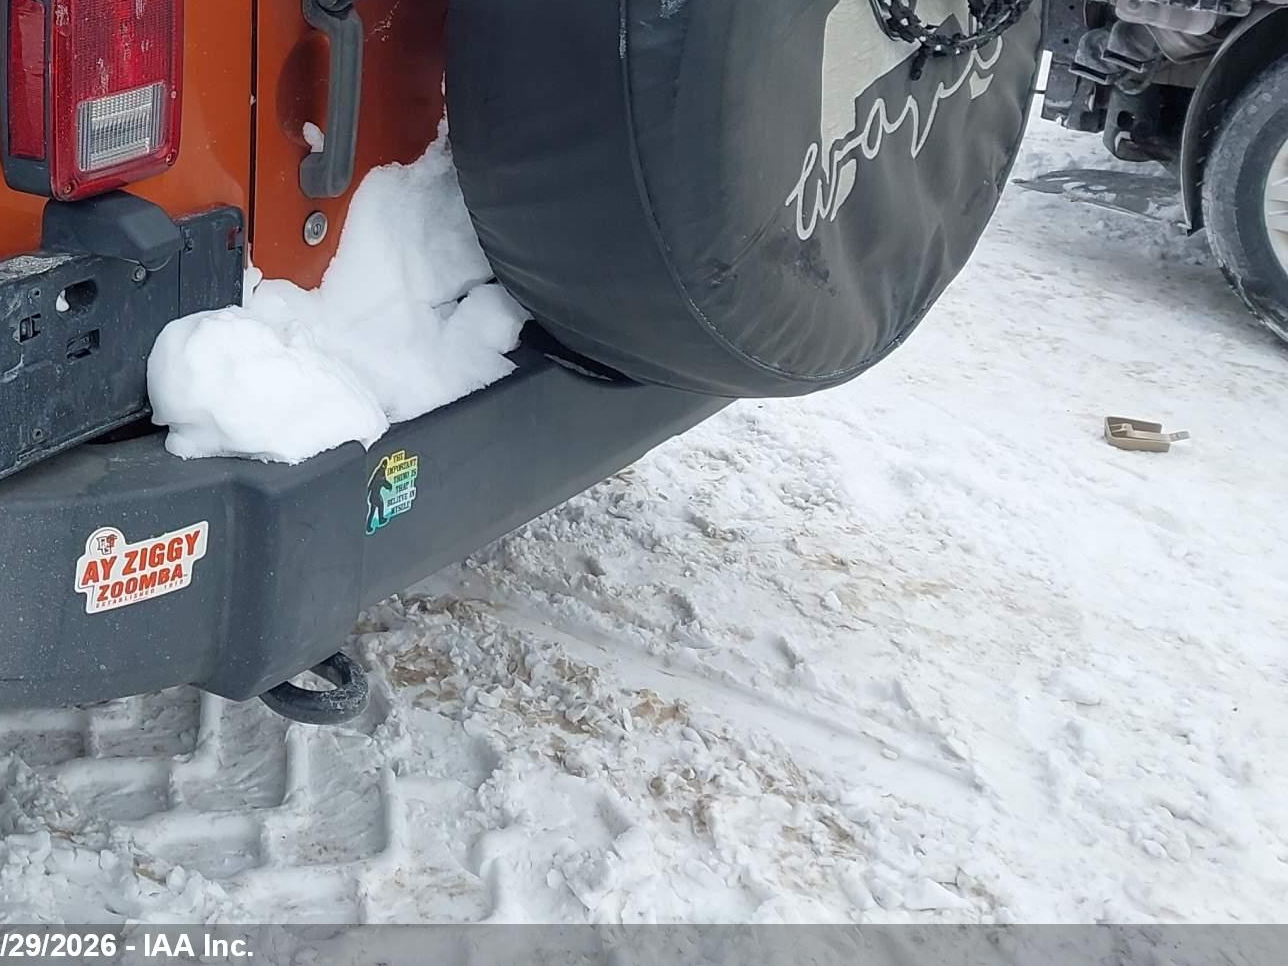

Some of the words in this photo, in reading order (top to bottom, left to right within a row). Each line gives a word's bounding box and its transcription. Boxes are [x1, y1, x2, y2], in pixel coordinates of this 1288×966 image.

[393, 453, 403, 462] THE
[388, 459, 416, 474] IMPORTANT
[411, 469, 416, 477] IS
[396, 482, 409, 493] THAT
[388, 494, 408, 506] BELIEVE
[409, 490, 415, 498] IN
[391, 502, 409, 514] MYSELF
[81, 556, 117, 585] AY
[122, 530, 200, 575] ZIGGY
[97, 564, 183, 602] ZOOMBA
[96, 589, 155, 608] ESTABLISHED
